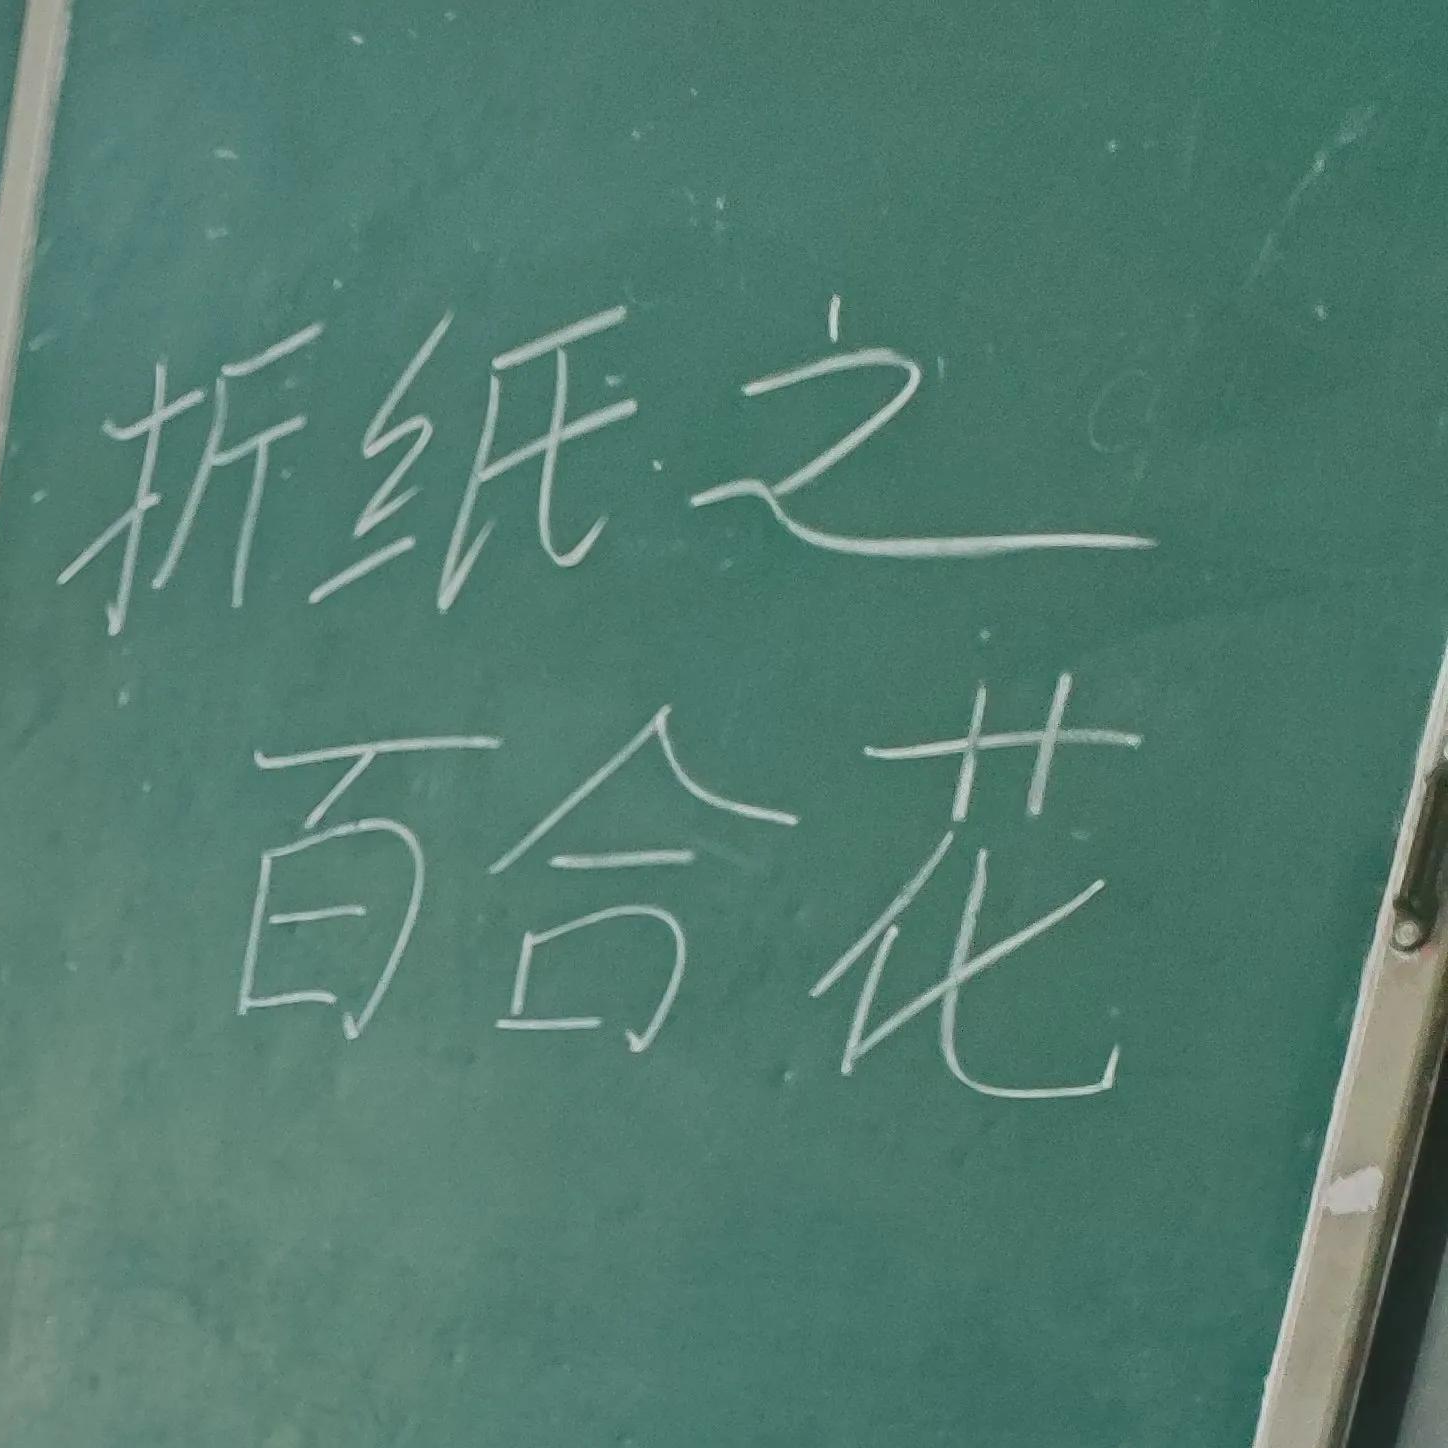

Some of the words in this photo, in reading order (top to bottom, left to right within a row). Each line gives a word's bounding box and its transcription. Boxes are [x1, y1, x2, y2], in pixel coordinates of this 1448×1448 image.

[57, 293, 1160, 636] 折纸之
[236, 672, 1144, 1099] 百合花
